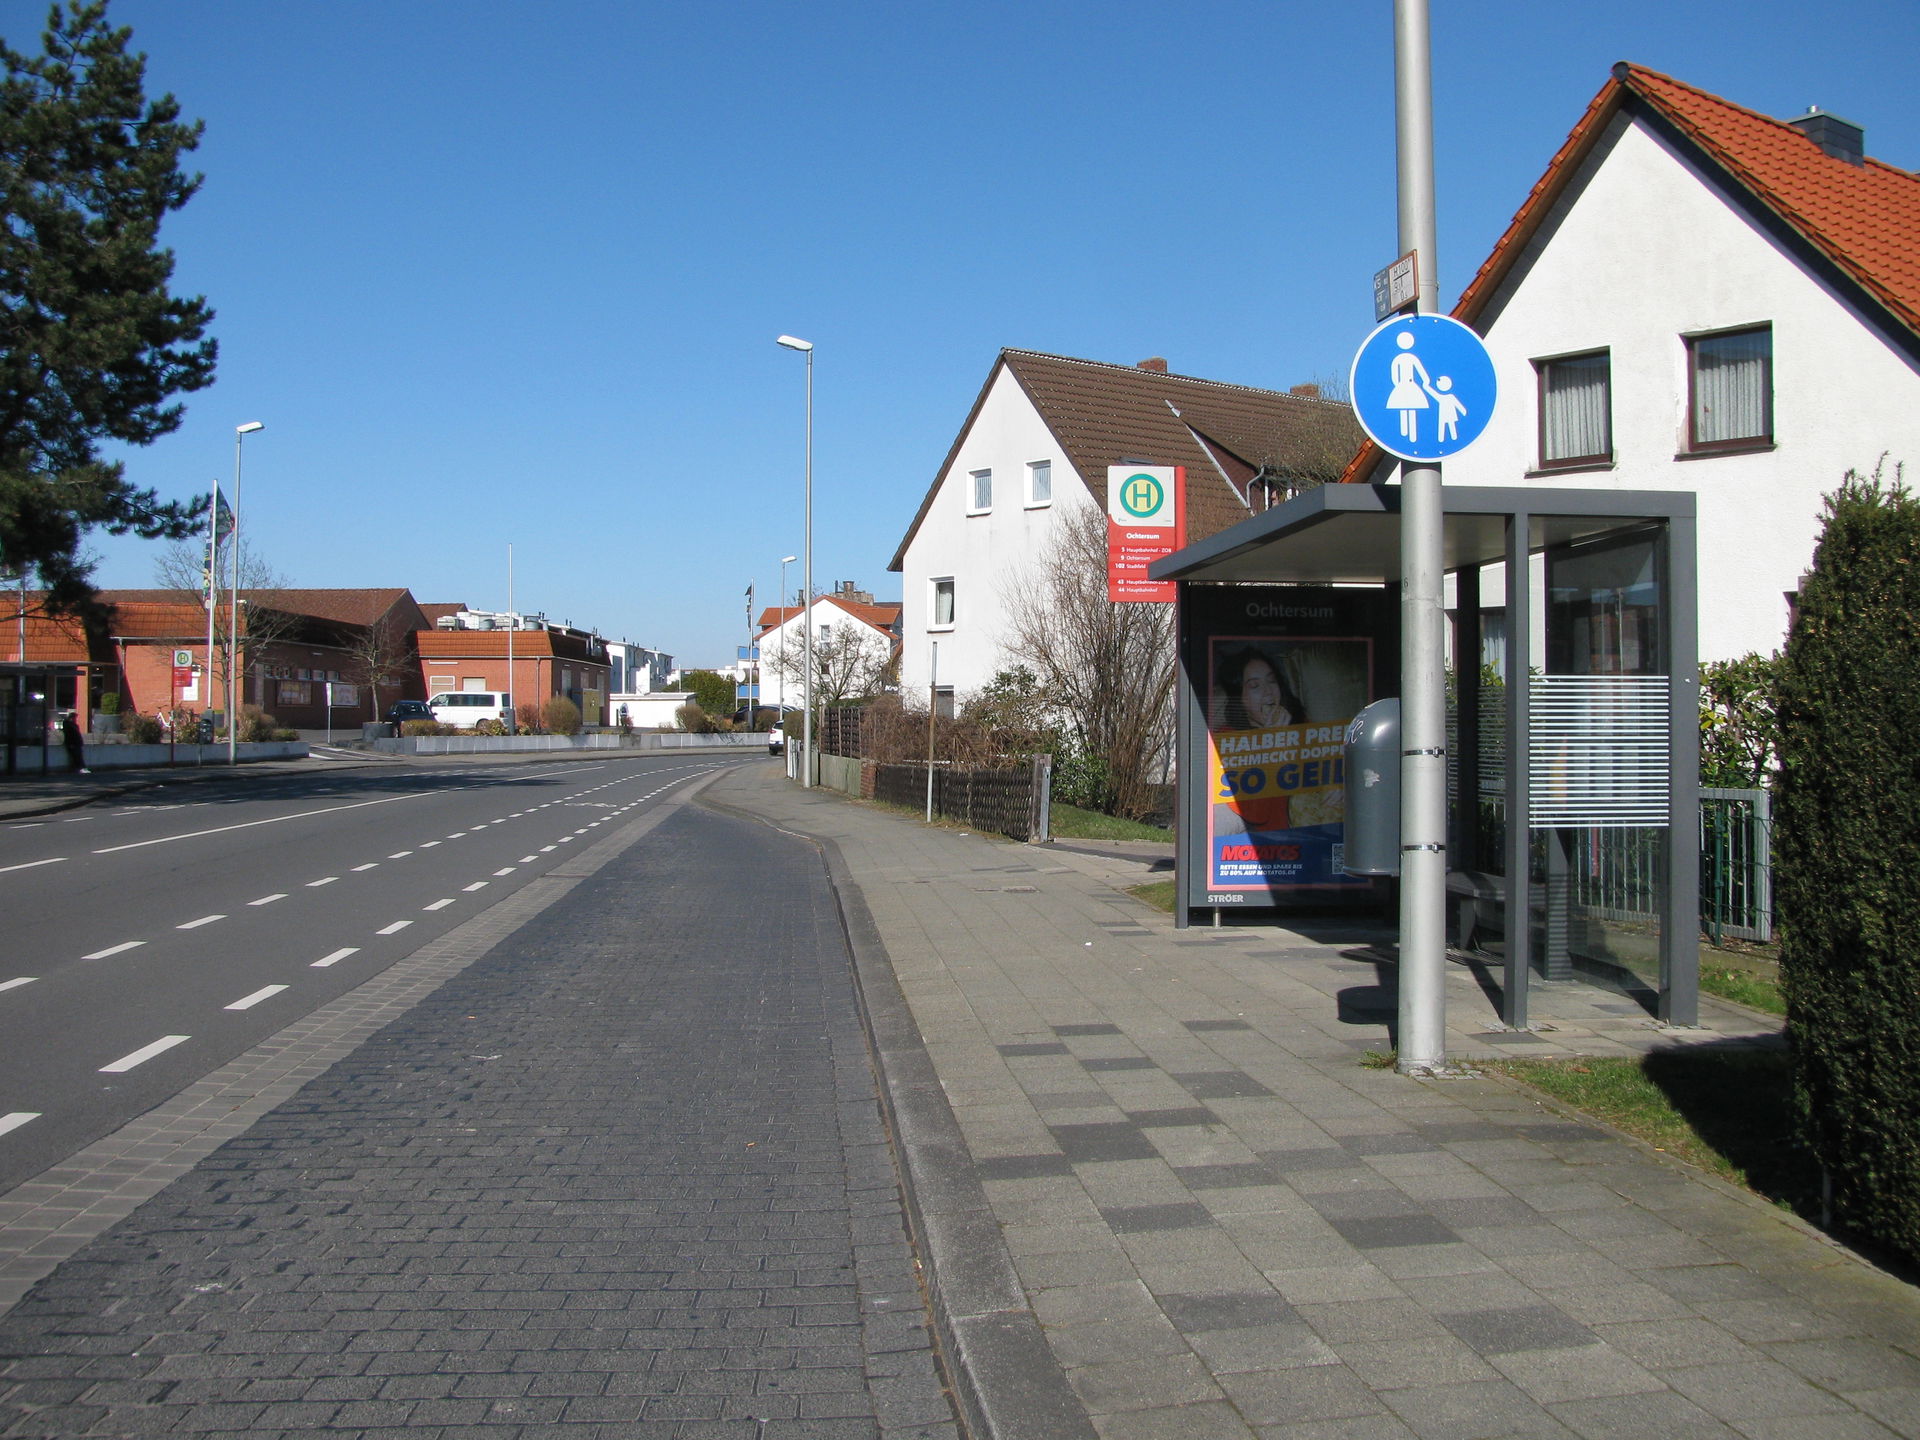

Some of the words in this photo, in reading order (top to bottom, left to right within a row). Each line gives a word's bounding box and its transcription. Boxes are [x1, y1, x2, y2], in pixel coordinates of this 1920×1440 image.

[1133, 483, 1151, 508] H
[1126, 532, 1160, 540] Ochtersum
[1245, 601, 1334, 617] Ochtersum
[1220, 730, 1299, 754] HALBER
[1221, 749, 1297, 768] SCHMECKT
[1219, 767, 1266, 797] SO
[1276, 758, 1344, 790] GEIL
[1221, 845, 1301, 861] MOTATOS
[1207, 894, 1244, 903] STRÖER
